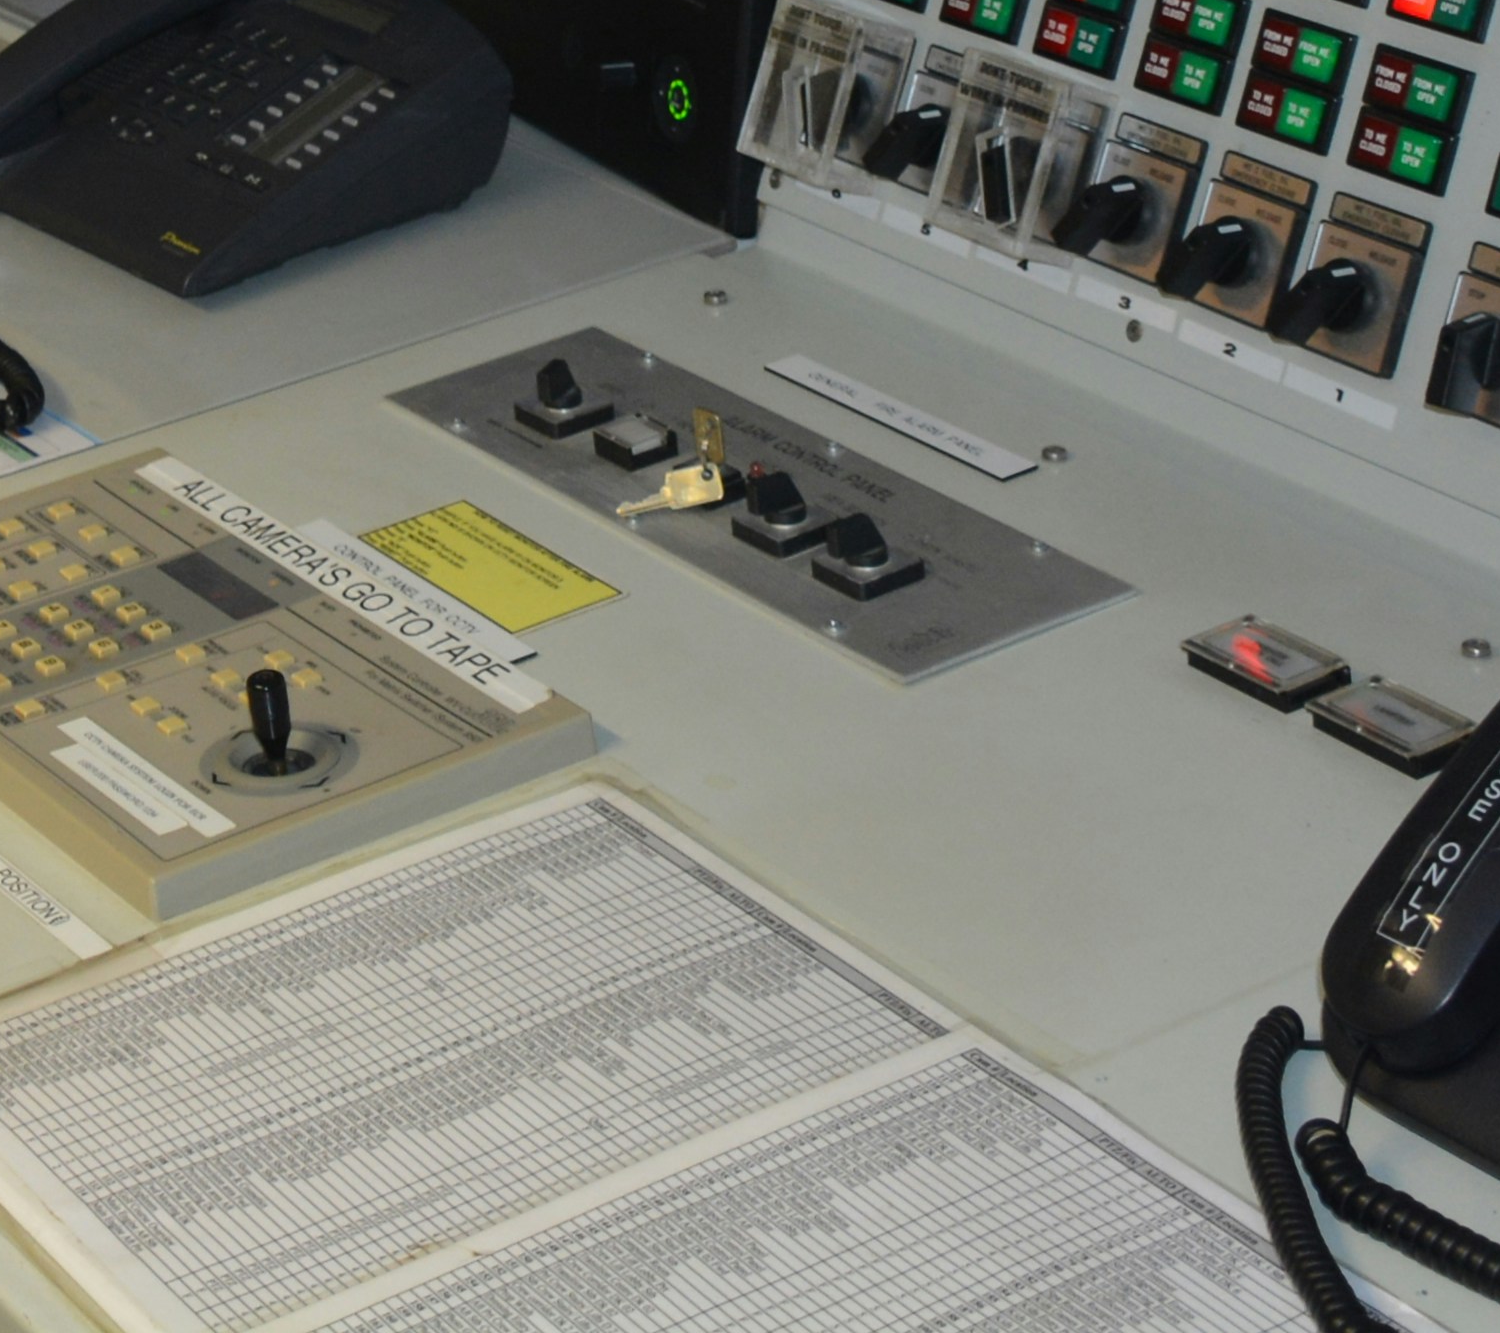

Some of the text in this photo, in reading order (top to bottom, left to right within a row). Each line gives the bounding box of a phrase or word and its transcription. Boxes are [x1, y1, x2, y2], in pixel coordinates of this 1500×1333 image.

[174, 480, 512, 686] ALL CAMERA'S GO TO TAPE
[1398, 841, 1461, 932] ONLY
